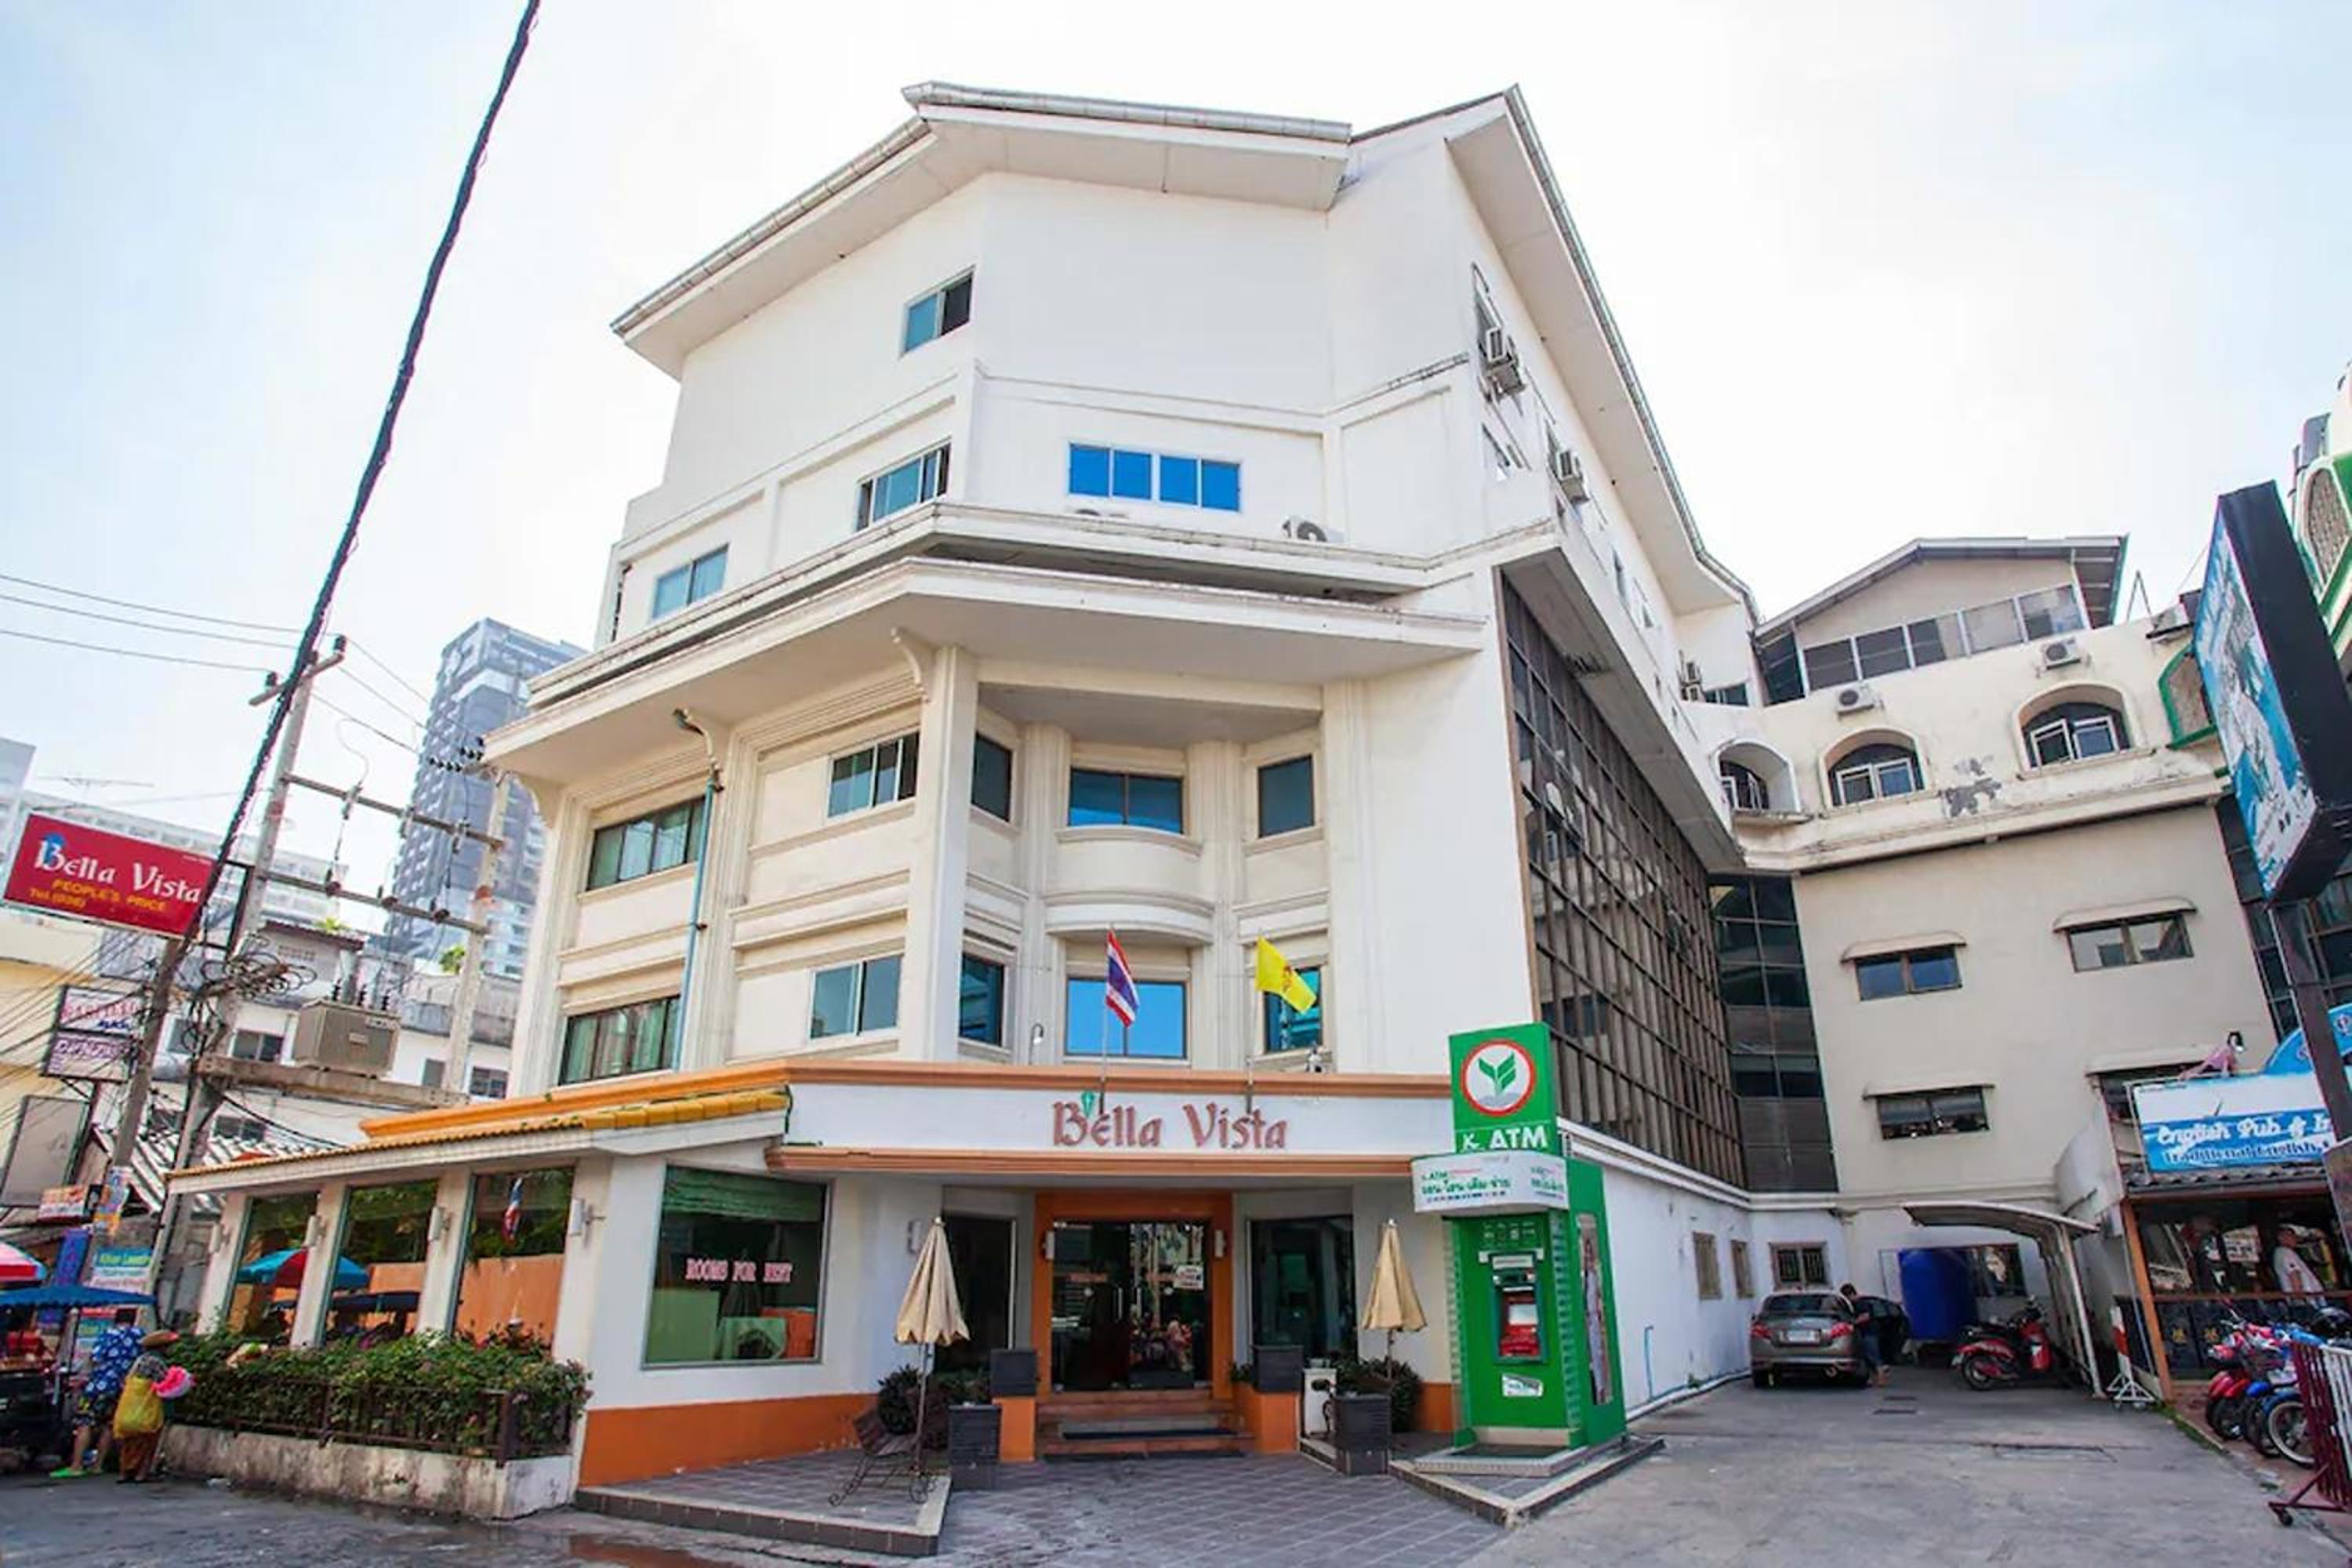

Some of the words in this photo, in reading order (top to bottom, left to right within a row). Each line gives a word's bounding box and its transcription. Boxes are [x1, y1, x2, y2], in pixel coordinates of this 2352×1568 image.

[34, 839, 116, 884] Bella
[132, 862, 201, 903] Vista
[1052, 1100, 1163, 1147] Bella
[1182, 1102, 1288, 1149] Vista
[685, 1258, 728, 1282] ROOMS
[731, 1260, 757, 1282] FOR
